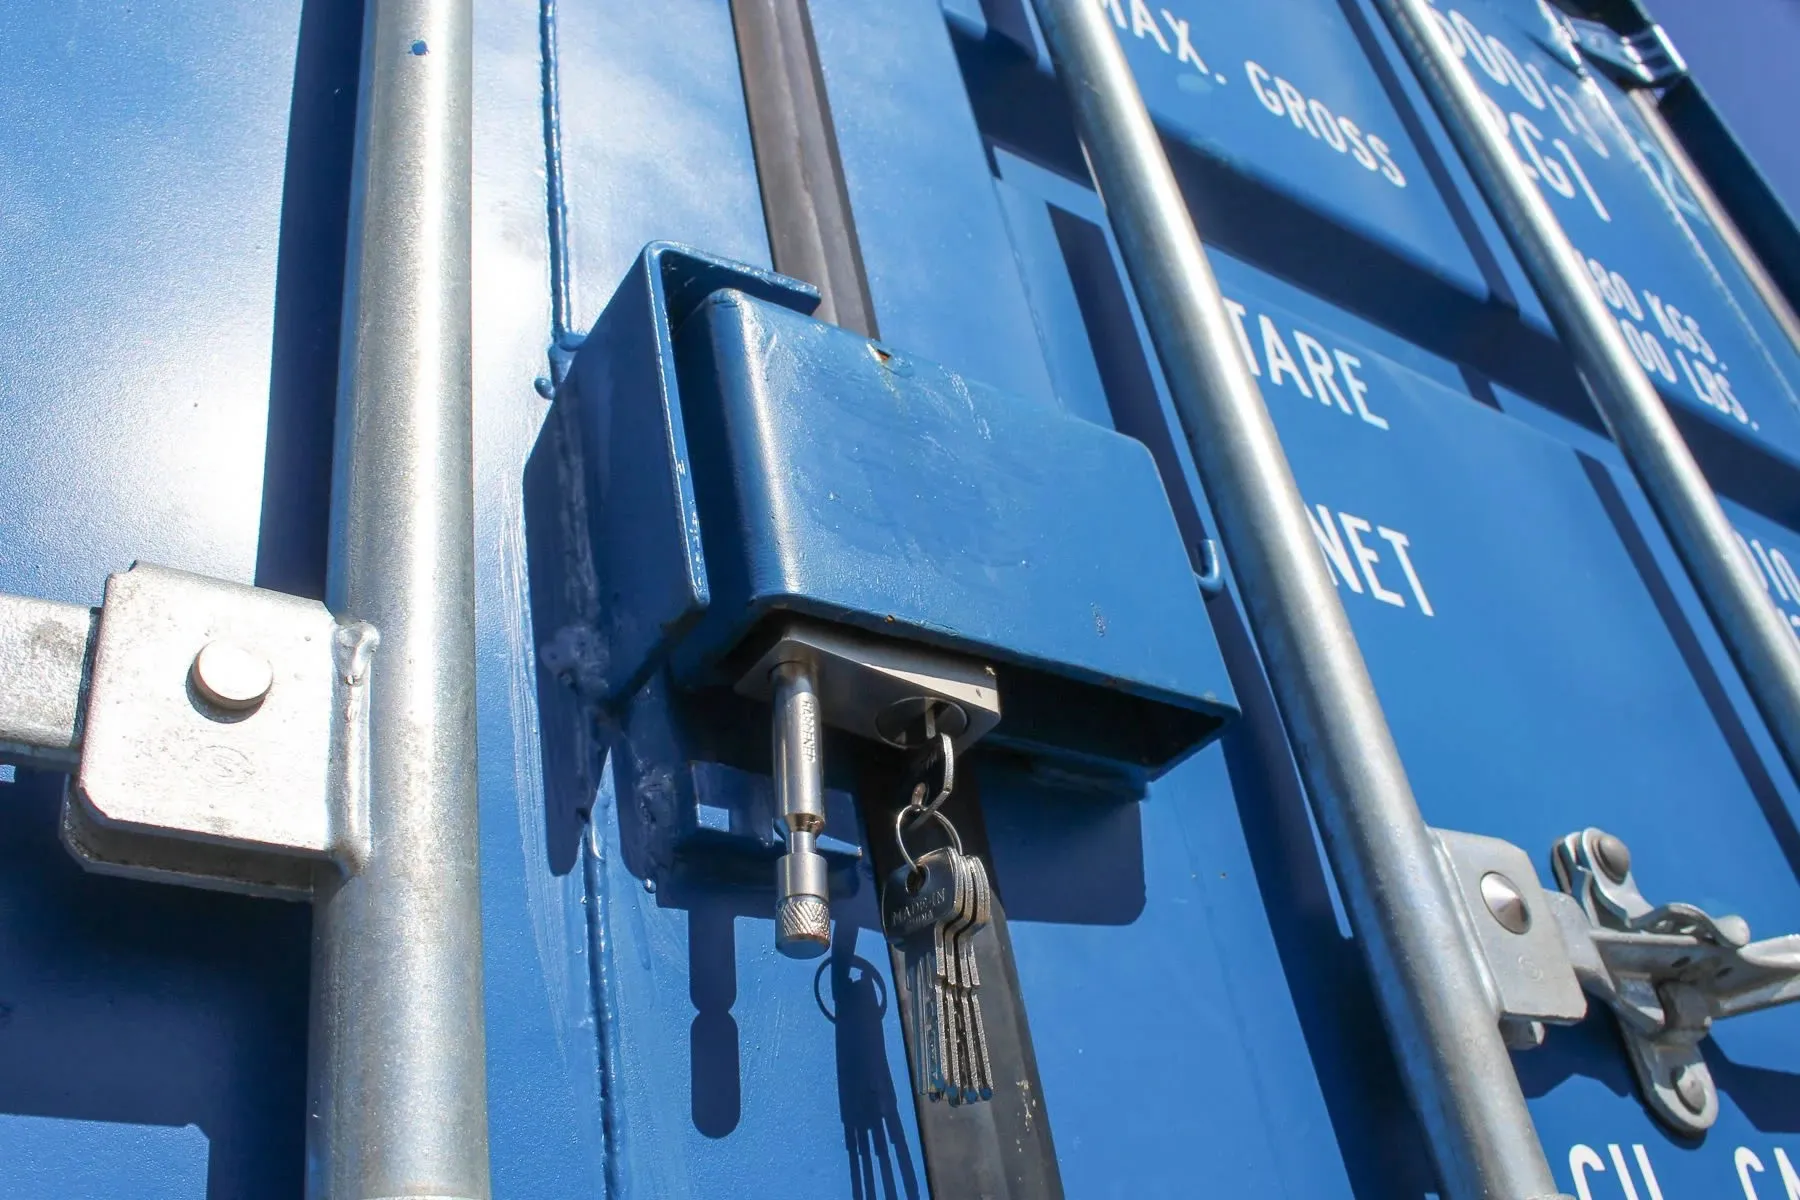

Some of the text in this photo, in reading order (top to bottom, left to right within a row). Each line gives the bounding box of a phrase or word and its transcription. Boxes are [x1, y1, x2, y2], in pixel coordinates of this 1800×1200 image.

[1244, 60, 1406, 187] GROSS
[1222, 296, 1389, 430] TARE
[1304, 502, 1434, 616] NET
